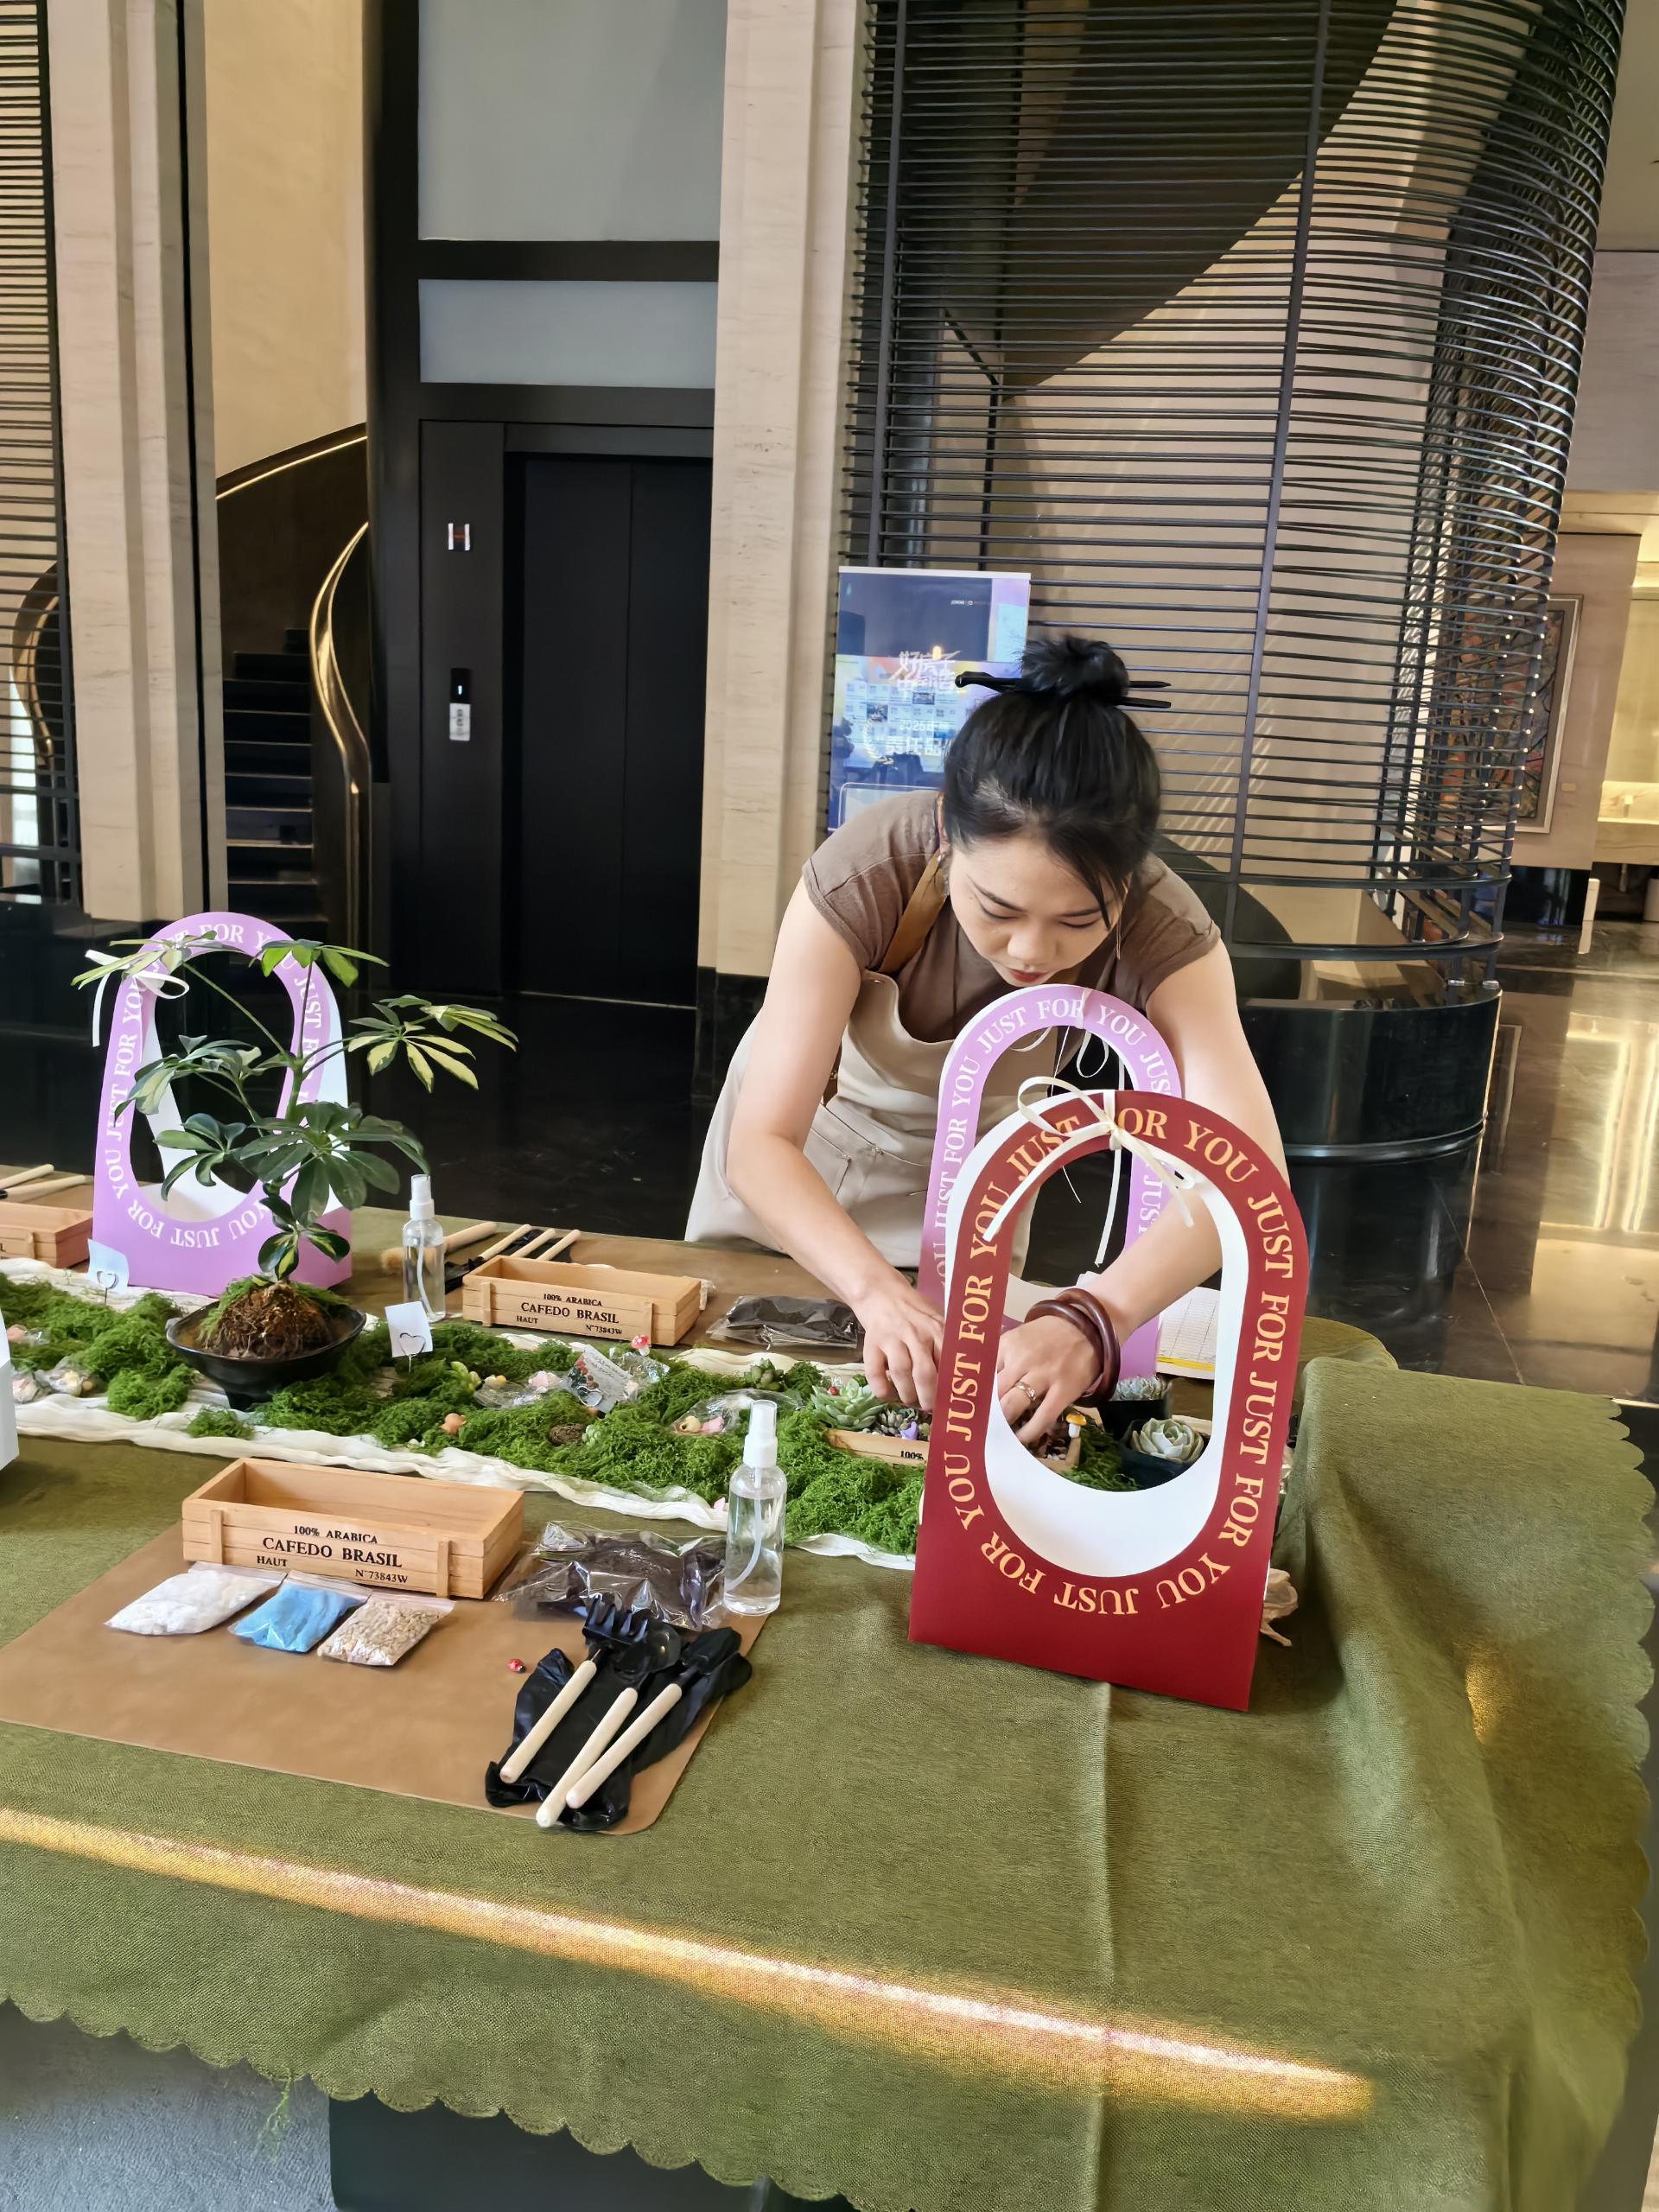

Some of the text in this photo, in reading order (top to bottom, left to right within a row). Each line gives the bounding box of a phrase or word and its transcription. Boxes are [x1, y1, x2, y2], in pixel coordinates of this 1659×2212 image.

[976, 1006, 1027, 1055] JUST
[1096, 1004, 1147, 1046] YOU
[114, 1033, 137, 1077] FOR
[1140, 1050, 1173, 1096] JUS
[951, 1056, 982, 1108] YOU
[944, 1118, 969, 1165] FOR
[1117, 1107, 1168, 1140] OR
[1007, 1116, 1080, 1182] JUST
[1184, 1120, 1259, 1183] YOU
[105, 1149, 129, 1199] YOU
[128, 1198, 165, 1239] FOR
[170, 1227, 220, 1249] JUST
[1247, 1191, 1294, 1279] JUST
[516, 1315, 539, 1325] HAUT
[521, 1302, 620, 1324] CAFEDO BRASIL
[543, 1294, 603, 1307] 100% ARABICA
[958, 1274, 993, 1344] FOR
[1252, 1290, 1290, 1363] FOR
[946, 1352, 982, 1442] JUST
[1239, 1371, 1278, 1465] JUST
[900, 1450, 925, 1461] 100%
[944, 1451, 985, 1530] YOU
[1217, 1472, 1264, 1548] FOR
[263, 1537, 403, 1568] CAFEDO BRASIL
[294, 1526, 378, 1544] 100% ARABICA
[257, 1555, 288, 1567] HAUT
[981, 1530, 1047, 1594] FOR
[1155, 1552, 1230, 1609] YOU
[1053, 1581, 1139, 1615] JUST
